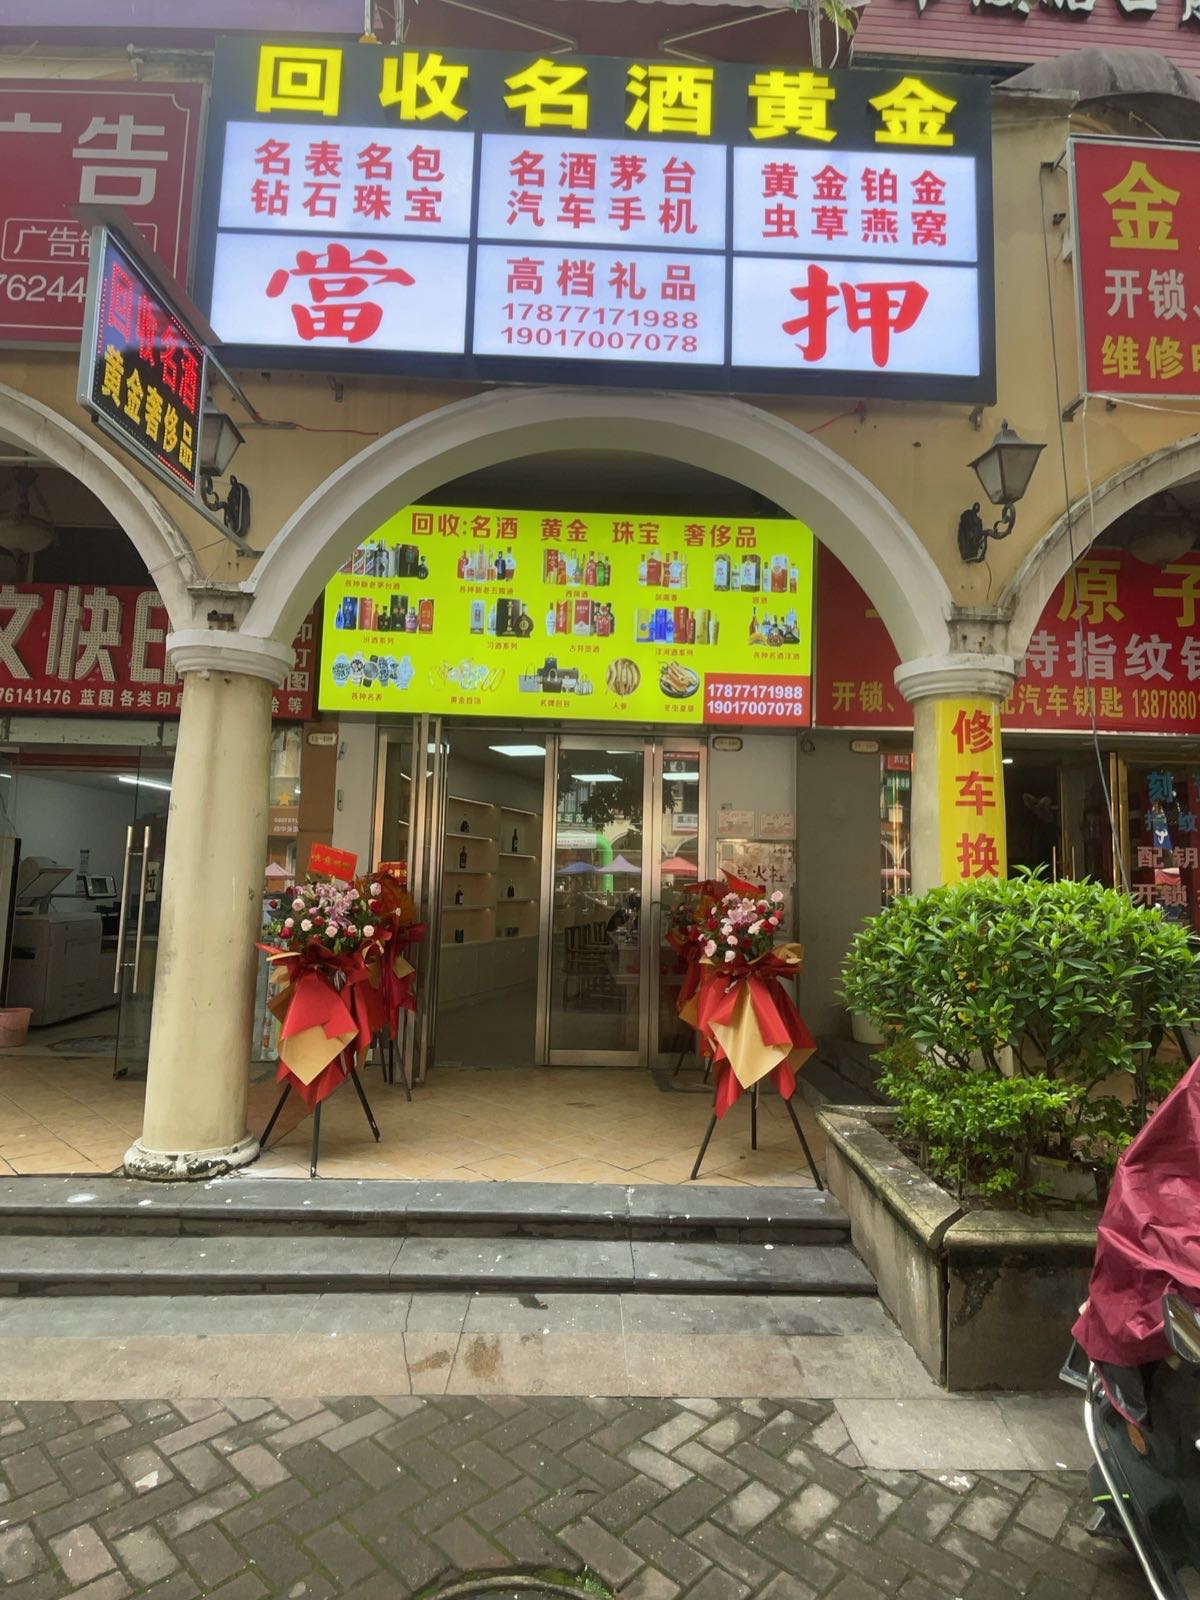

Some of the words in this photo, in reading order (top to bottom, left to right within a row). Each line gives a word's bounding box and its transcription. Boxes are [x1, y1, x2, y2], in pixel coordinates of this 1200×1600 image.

[255, 45, 957, 147] 回收名酒黄金
[254, 137, 445, 183] 名表名包
[509, 149, 696, 194] 名酒茅台
[250, 179, 443, 223] 钻石珠宝
[761, 162, 947, 206] 黄金铂金
[506, 189, 698, 235] 汽车手机
[761, 205, 948, 247] 虫草燕窝
[265, 243, 416, 343] 當
[506, 256, 696, 302] 高档礼品
[502, 302, 699, 329] 17877171988
[782, 263, 929, 368] 押
[107, 262, 199, 416] 回收名酒
[500, 326, 698, 353] 19017007078
[102, 344, 193, 472] 黄金奢侈品
[540, 518, 588, 543] 黄金
[612, 521, 660, 545] 珠宝
[683, 524, 758, 549] 奢侈品
[707, 683, 804, 700] 17877171988
[707, 700, 803, 717] 19017007078
[1132, 689, 1200, 719] 1387880
[1132, 883, 1200, 907] 开锁
